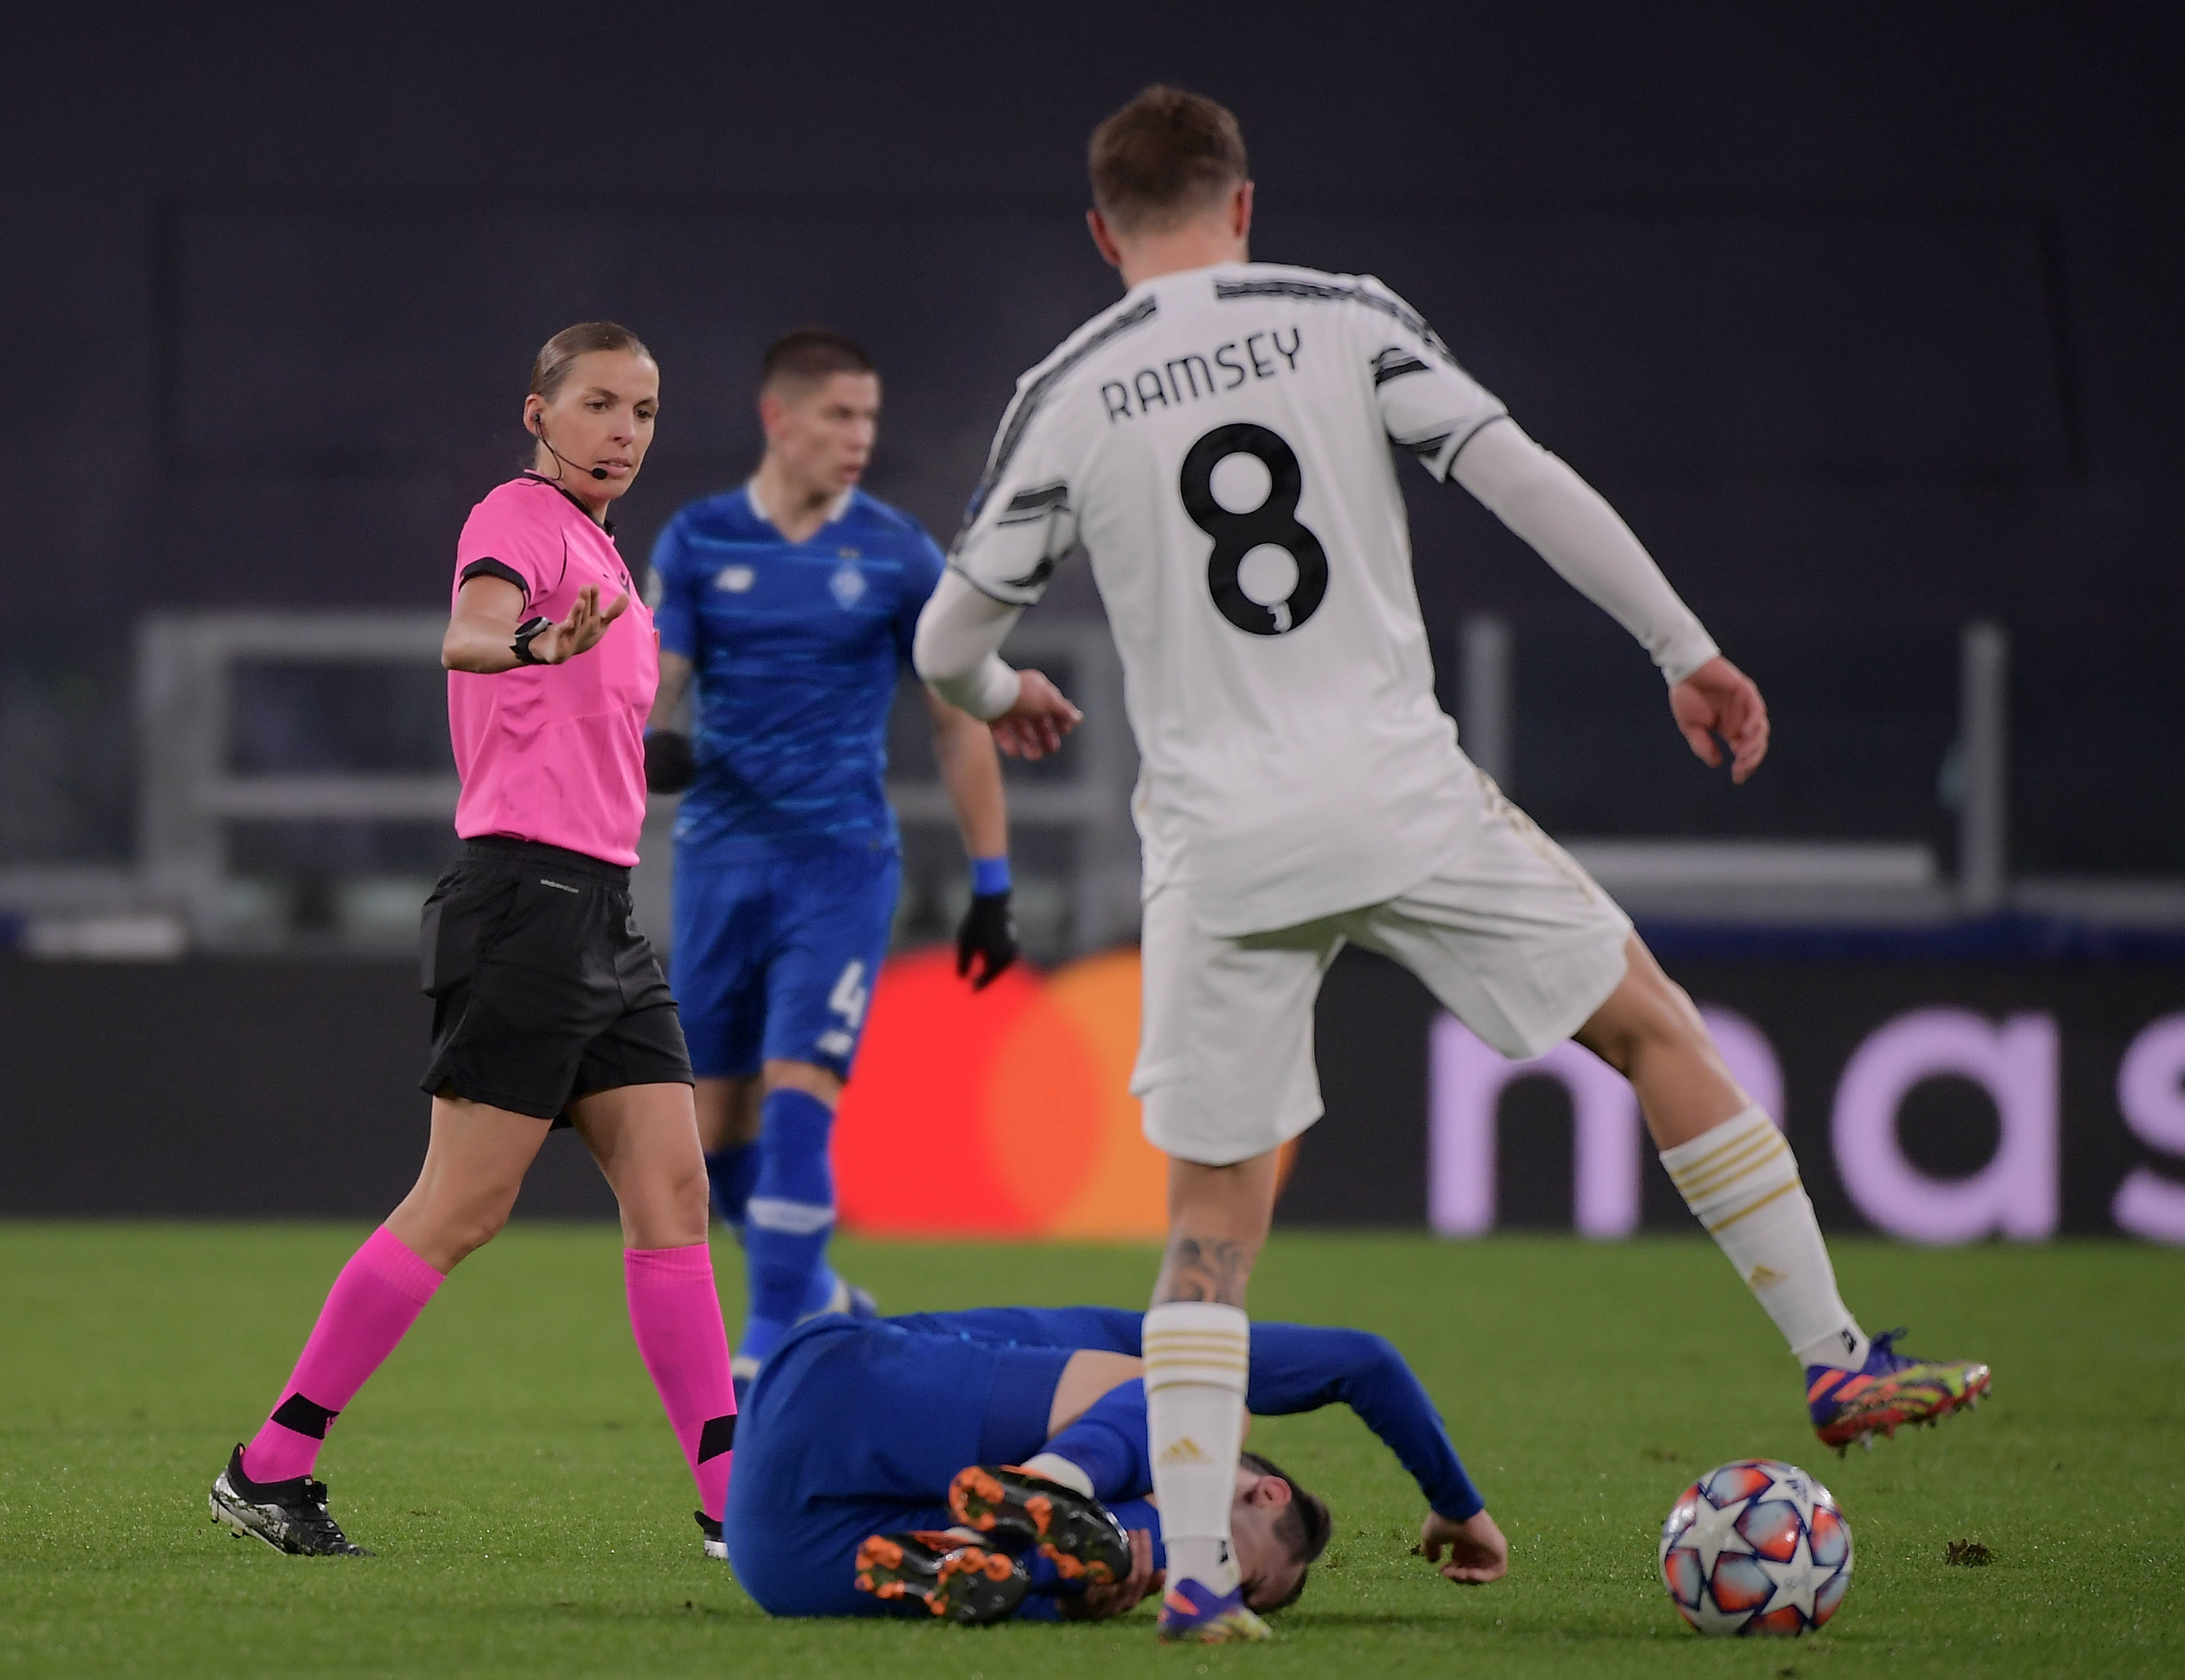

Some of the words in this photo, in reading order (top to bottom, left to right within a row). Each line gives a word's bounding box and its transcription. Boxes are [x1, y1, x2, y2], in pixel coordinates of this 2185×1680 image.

[1101, 328, 1300, 423] RAMSEY
[1180, 422, 1329, 635] 8
[828, 959, 866, 1029] 4
